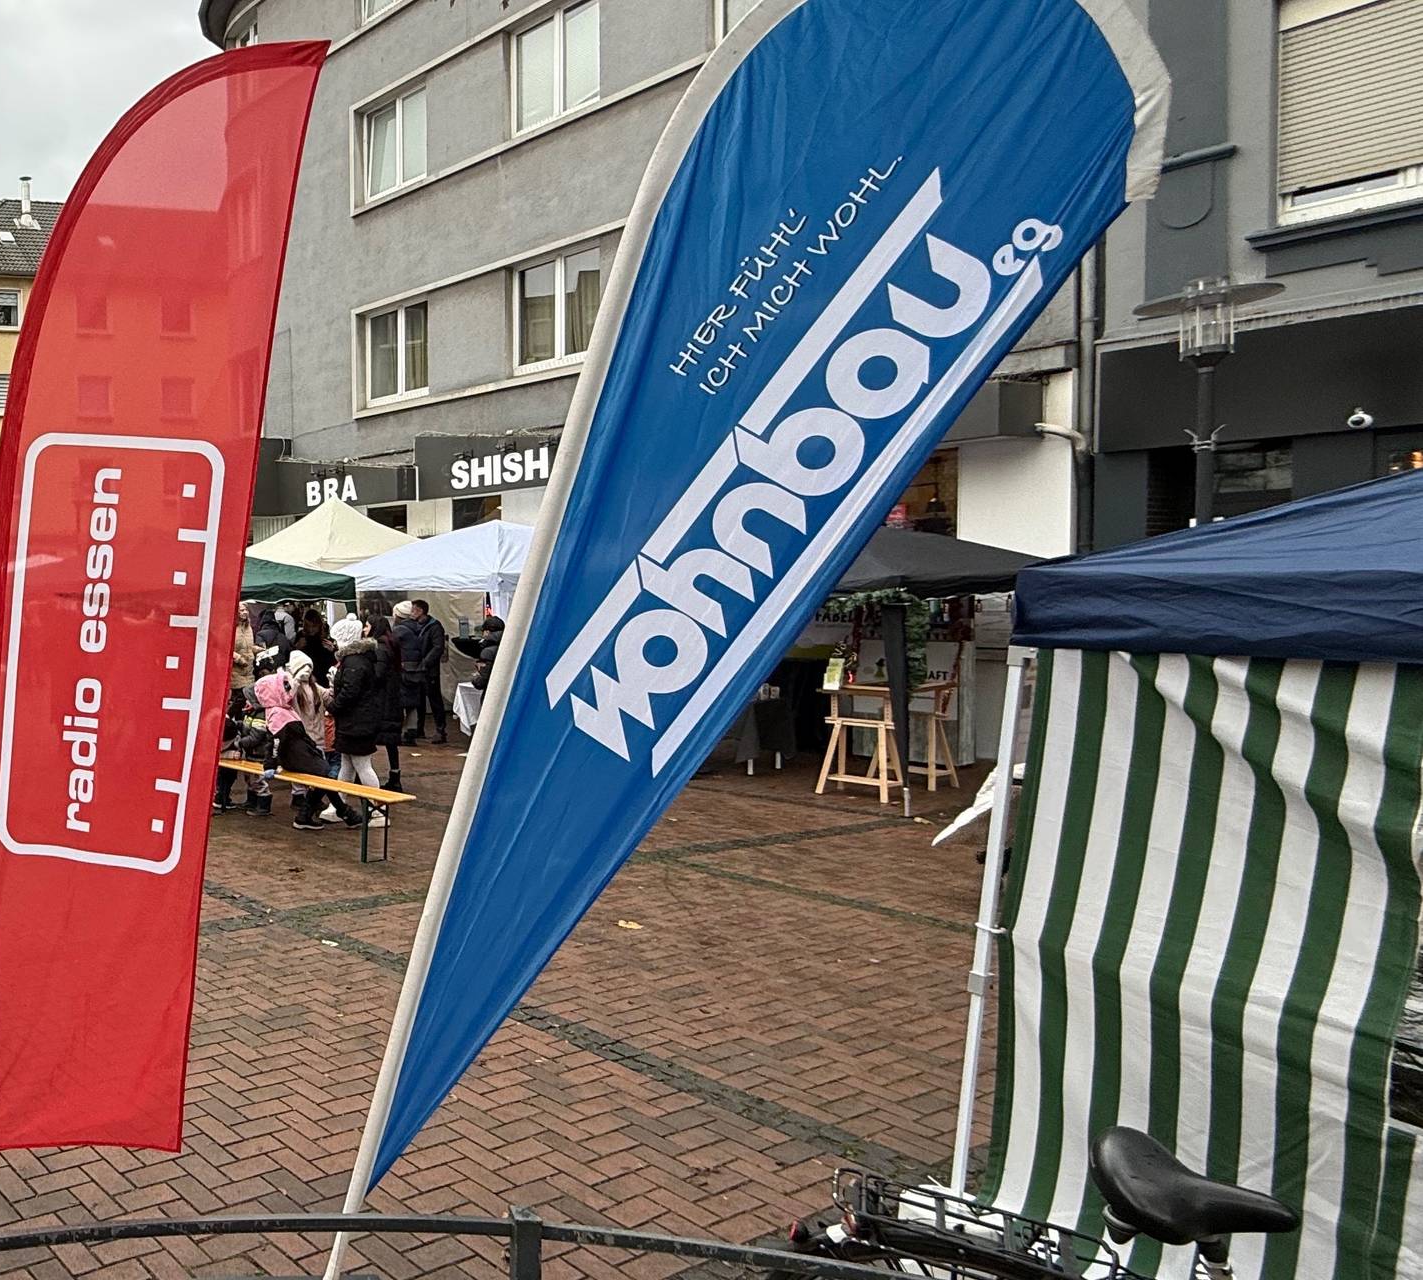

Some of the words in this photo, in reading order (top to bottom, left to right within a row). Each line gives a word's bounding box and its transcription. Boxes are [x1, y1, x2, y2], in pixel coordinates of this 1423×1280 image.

[699, 341, 748, 395] ICH
[742, 259, 813, 343] MICH
[806, 155, 904, 255] WOHL.
[669, 303, 738, 377] HIER
[305, 474, 358, 507] BRA
[450, 446, 549, 490] SHISH
[79, 467, 122, 653] essen
[62, 677, 103, 833] radio
